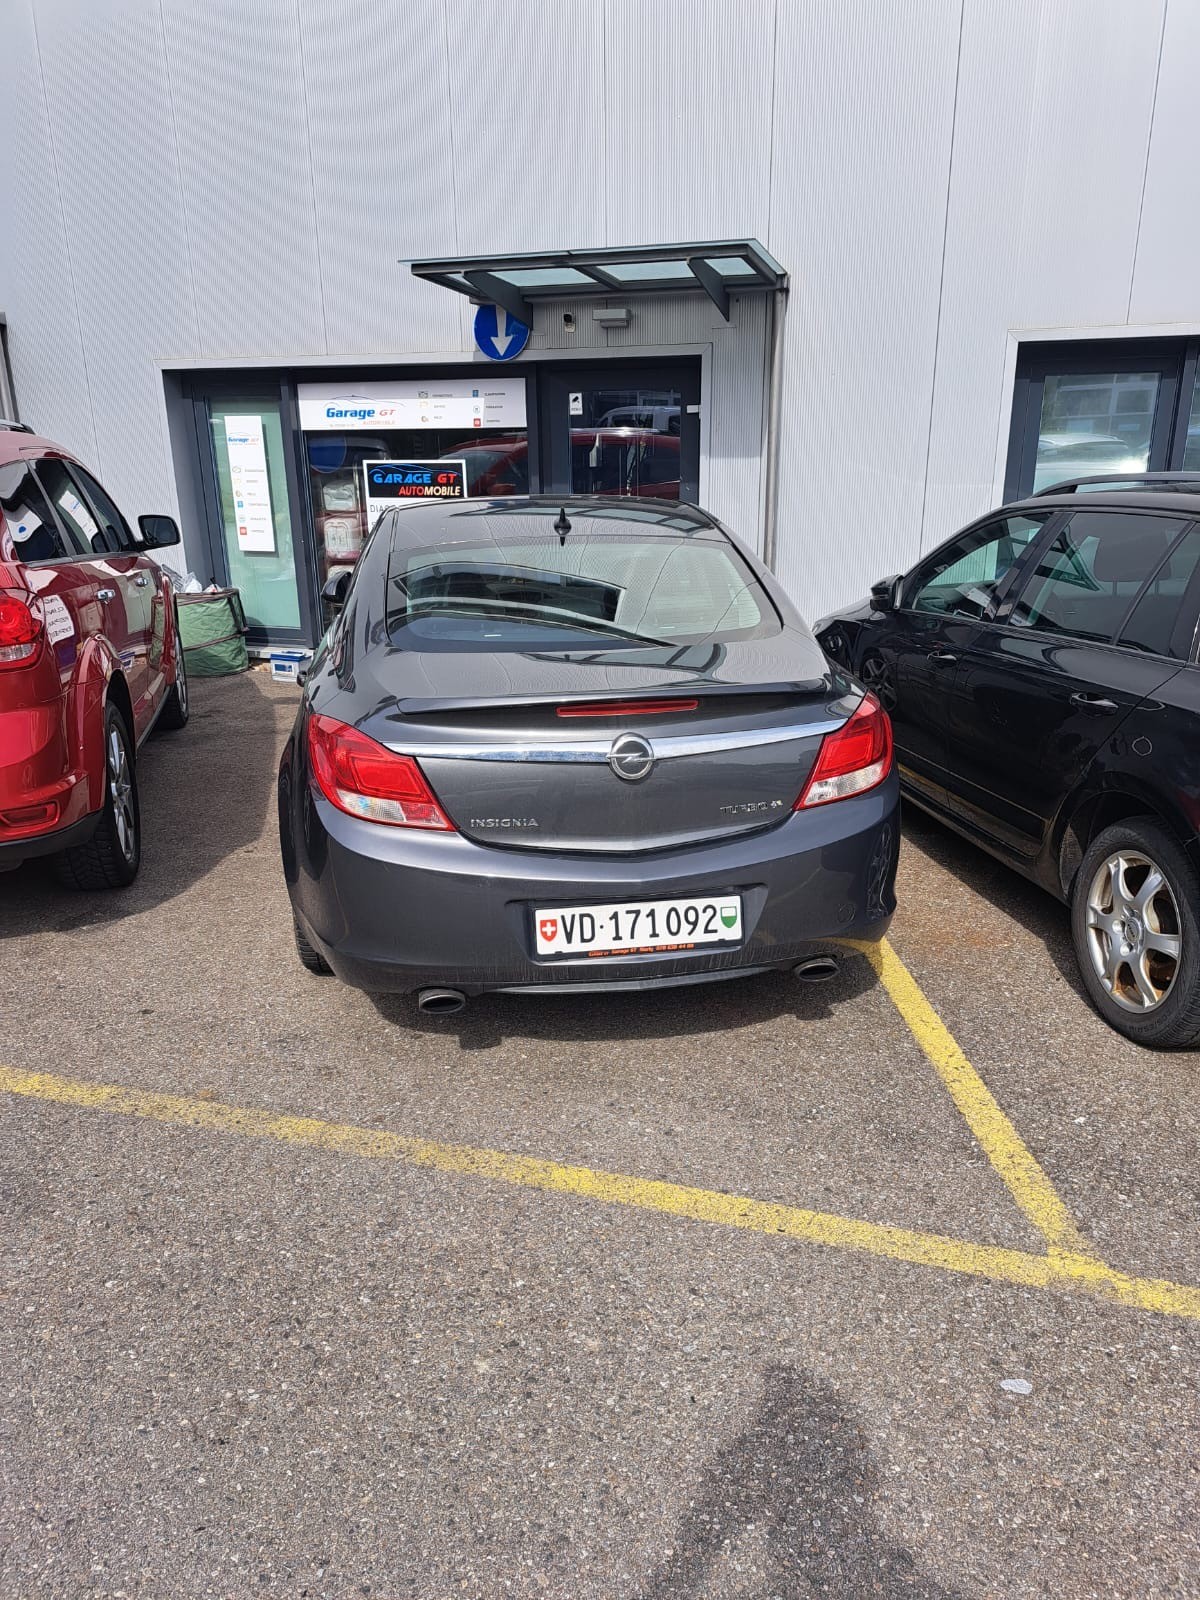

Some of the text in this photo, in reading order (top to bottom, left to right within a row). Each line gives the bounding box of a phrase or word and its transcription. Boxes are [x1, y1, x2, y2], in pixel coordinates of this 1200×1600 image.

[326, 408, 375, 420] Garage
[373, 473, 457, 484] GARAGE GT
[398, 486, 461, 496] AUTOMOBILE
[719, 801, 767, 813] TURBO
[470, 818, 538, 827] INSIGNIA
